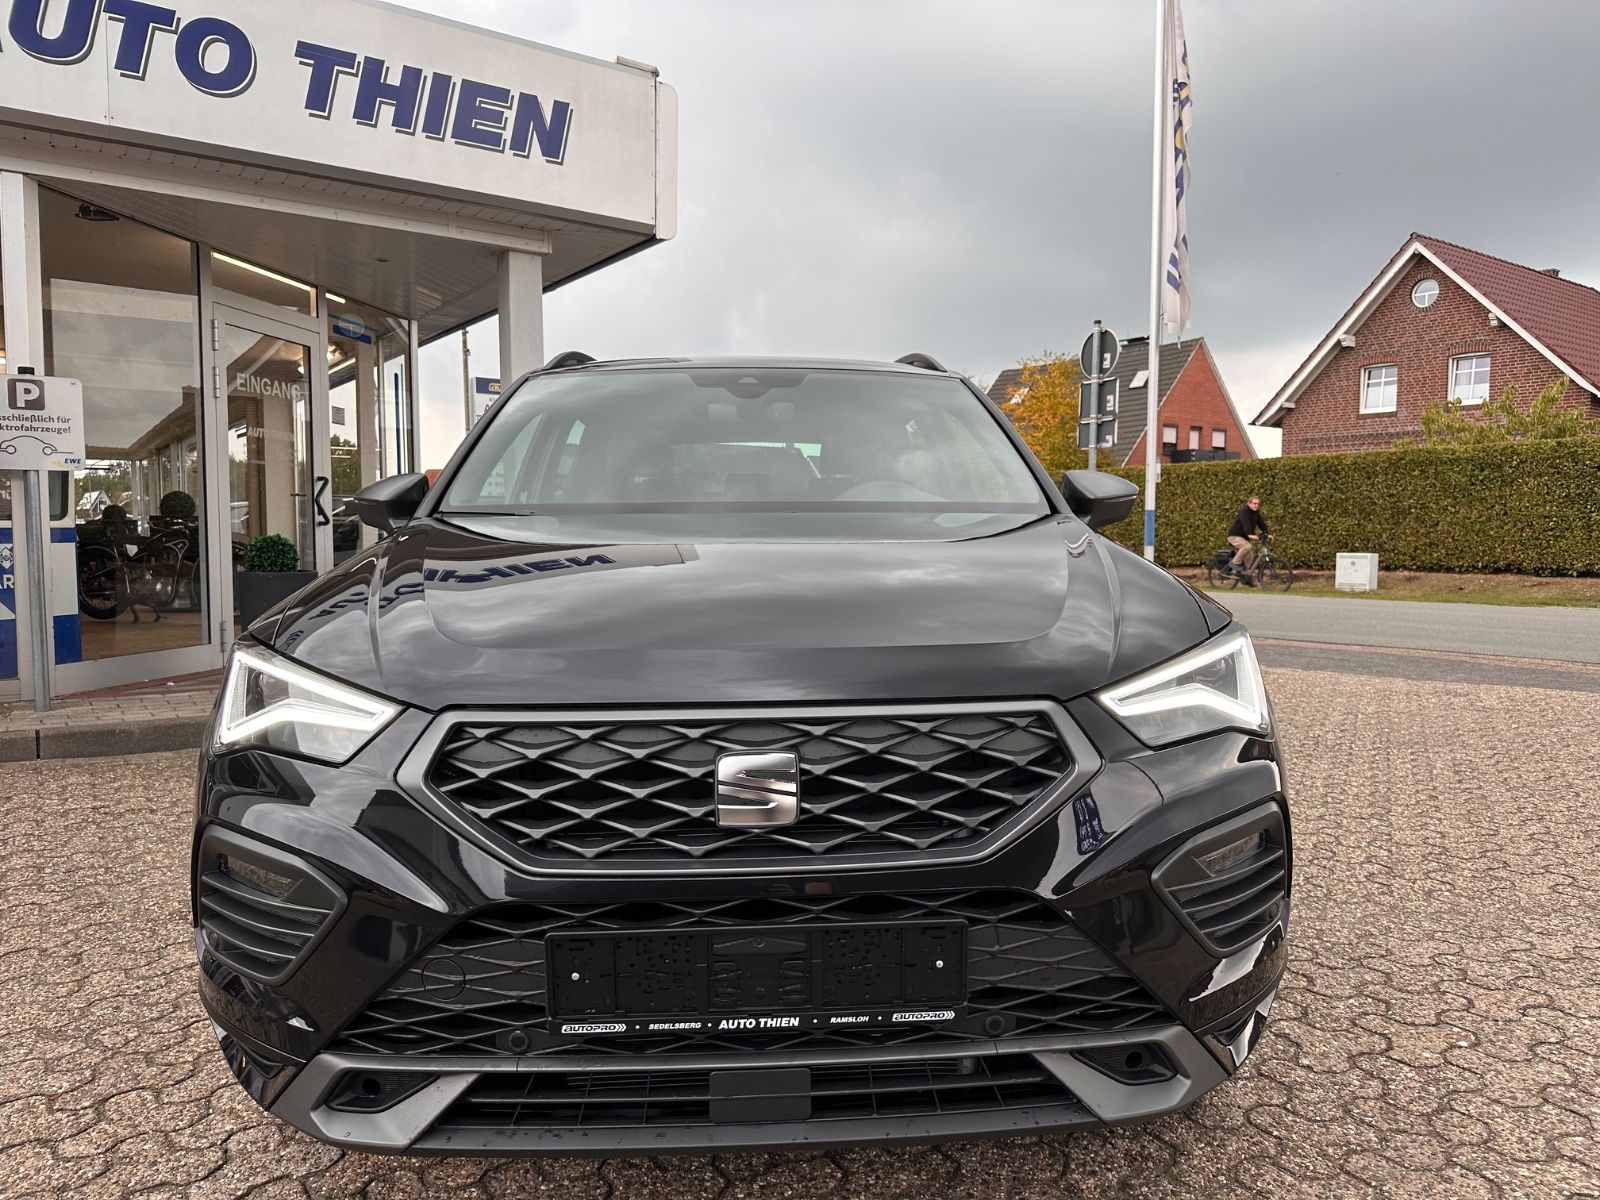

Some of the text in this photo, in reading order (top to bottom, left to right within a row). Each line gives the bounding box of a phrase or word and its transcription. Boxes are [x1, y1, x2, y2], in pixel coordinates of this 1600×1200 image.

[0, 0, 573, 165] UTO THIEN
[15, 381, 40, 408] P
[236, 372, 301, 400] EINGANG
[57, 415, 72, 424] für
[648, 1022, 702, 1030] SEDELSBERG
[718, 1018, 756, 1030] AUTO
[758, 1016, 800, 1028] THIEN
[829, 1016, 869, 1024] RAMSLOH
